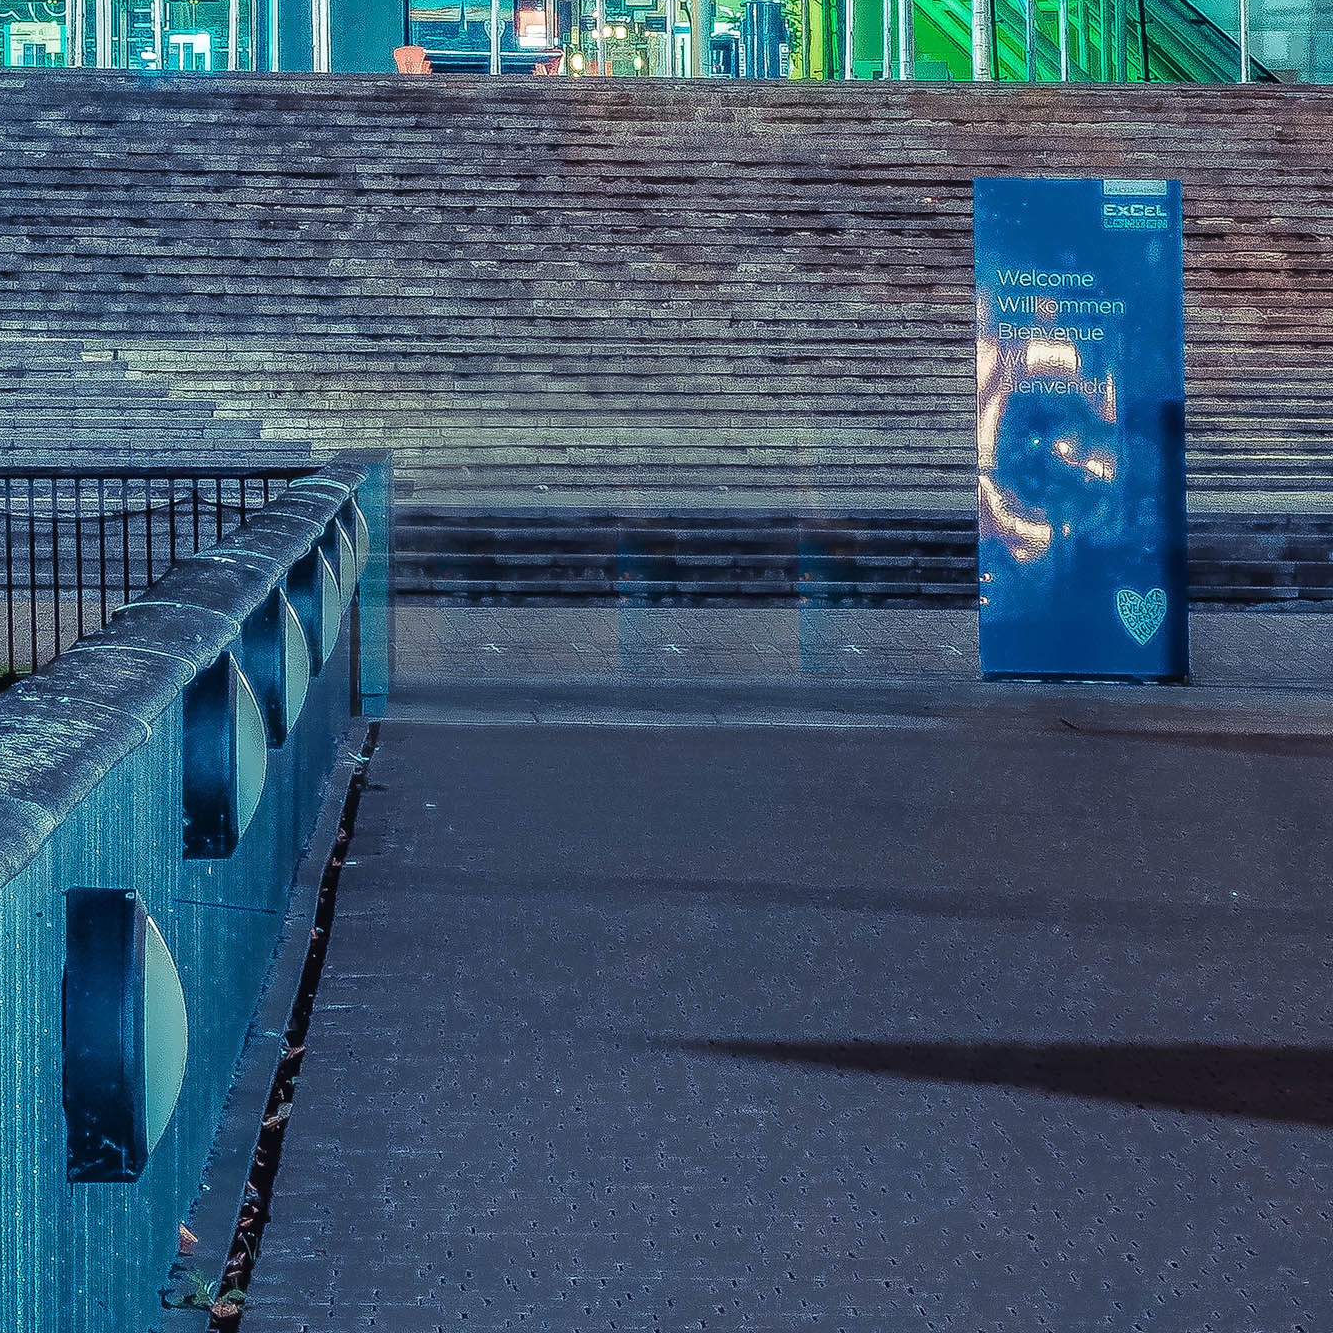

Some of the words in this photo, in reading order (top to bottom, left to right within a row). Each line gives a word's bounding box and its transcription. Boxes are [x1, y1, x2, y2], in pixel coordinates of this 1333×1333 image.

[1103, 219, 1168, 229] LONDON
[996, 269, 1094, 287] Welcome
[996, 296, 1125, 314] Willkommen
[998, 322, 1105, 341] Bienvenue
